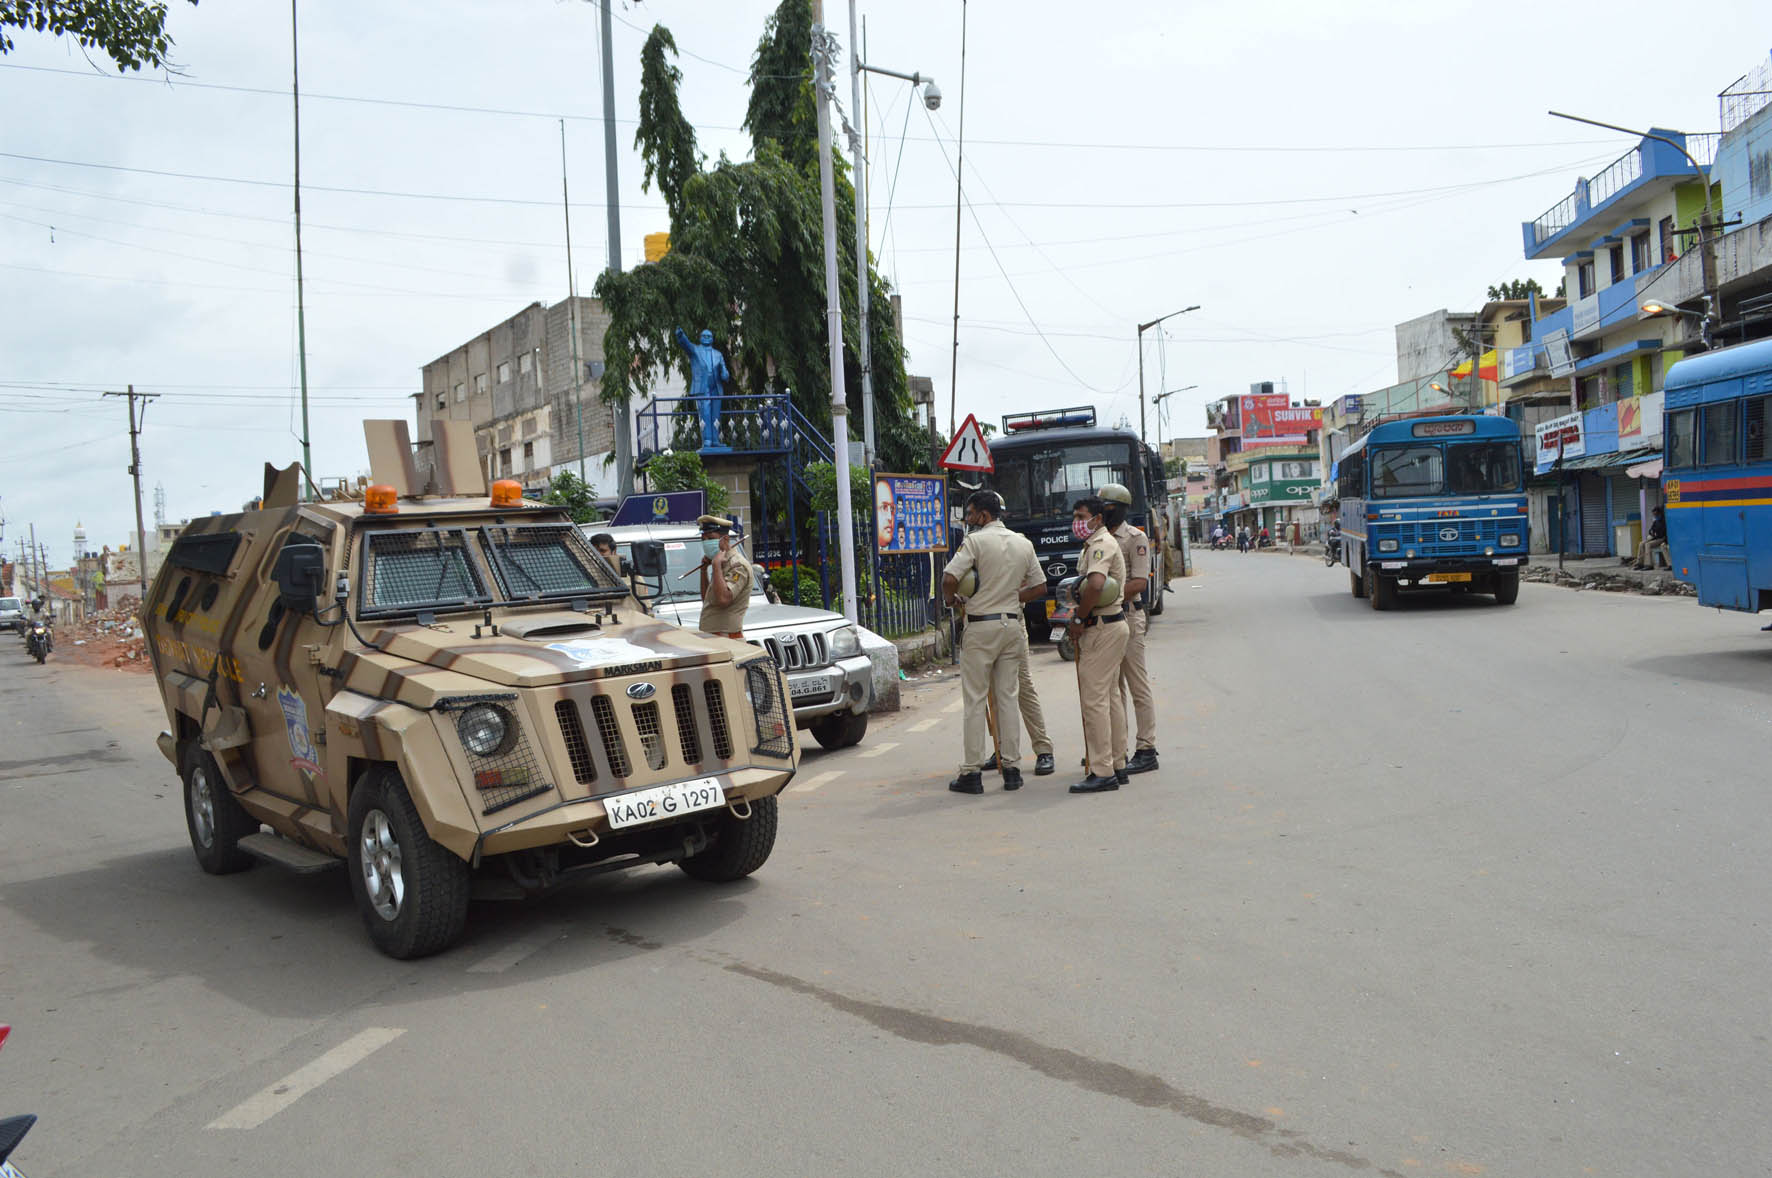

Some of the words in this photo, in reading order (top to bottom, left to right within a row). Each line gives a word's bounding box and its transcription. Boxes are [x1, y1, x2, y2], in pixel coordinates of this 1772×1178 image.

[1251, 488, 1269, 499] oppo
[1040, 535, 1069, 545] POLICE
[604, 660, 663, 677] MARKSMAN
[612, 799, 657, 824] KA02
[662, 797, 677, 813] G
[682, 787, 717, 809] 1297
